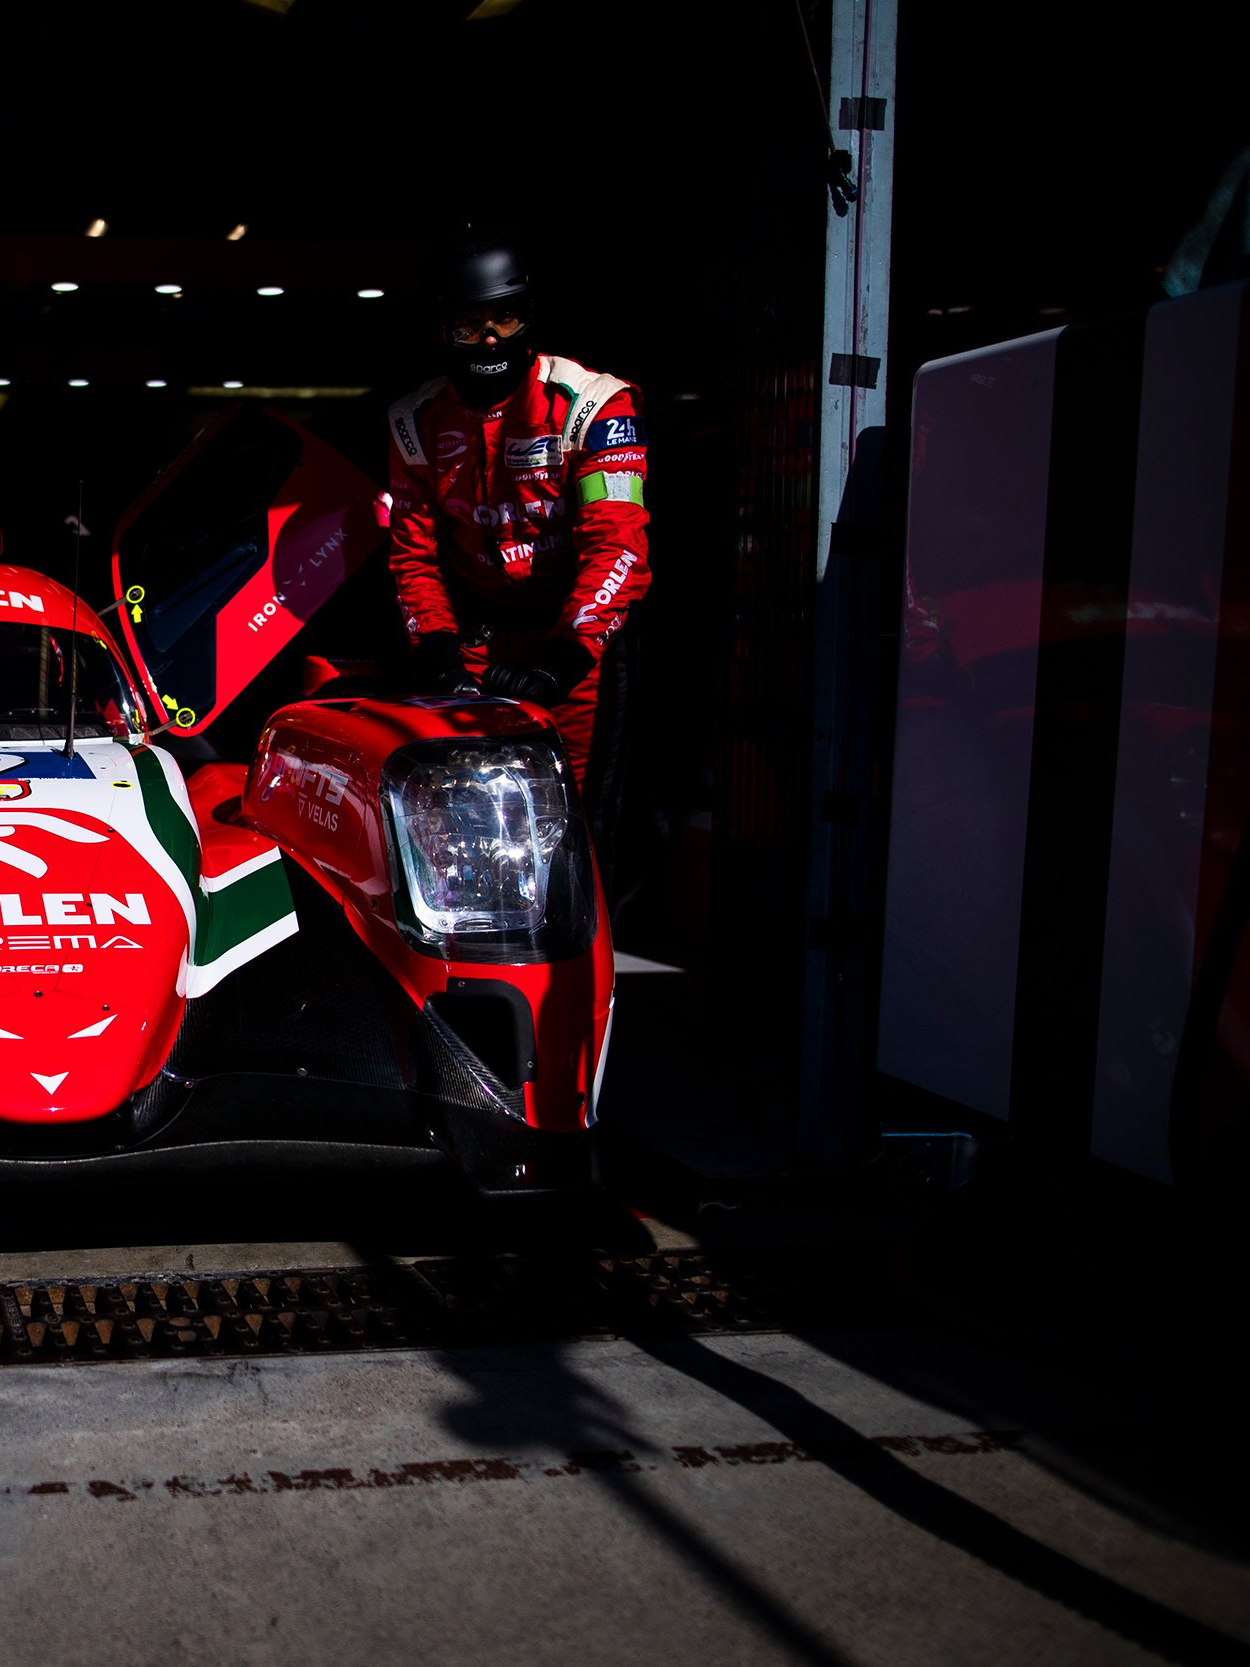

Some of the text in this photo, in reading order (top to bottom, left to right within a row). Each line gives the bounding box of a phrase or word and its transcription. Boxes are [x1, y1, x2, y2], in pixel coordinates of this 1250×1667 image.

[470, 361, 508, 375] sparco
[395, 417, 417, 457] sparco
[570, 400, 597, 443] sparco
[473, 498, 566, 527] ORLEN
[248, 527, 349, 632] IRON LYNX
[594, 549, 638, 605] ORLEN
[308, 801, 338, 833] VELAS
